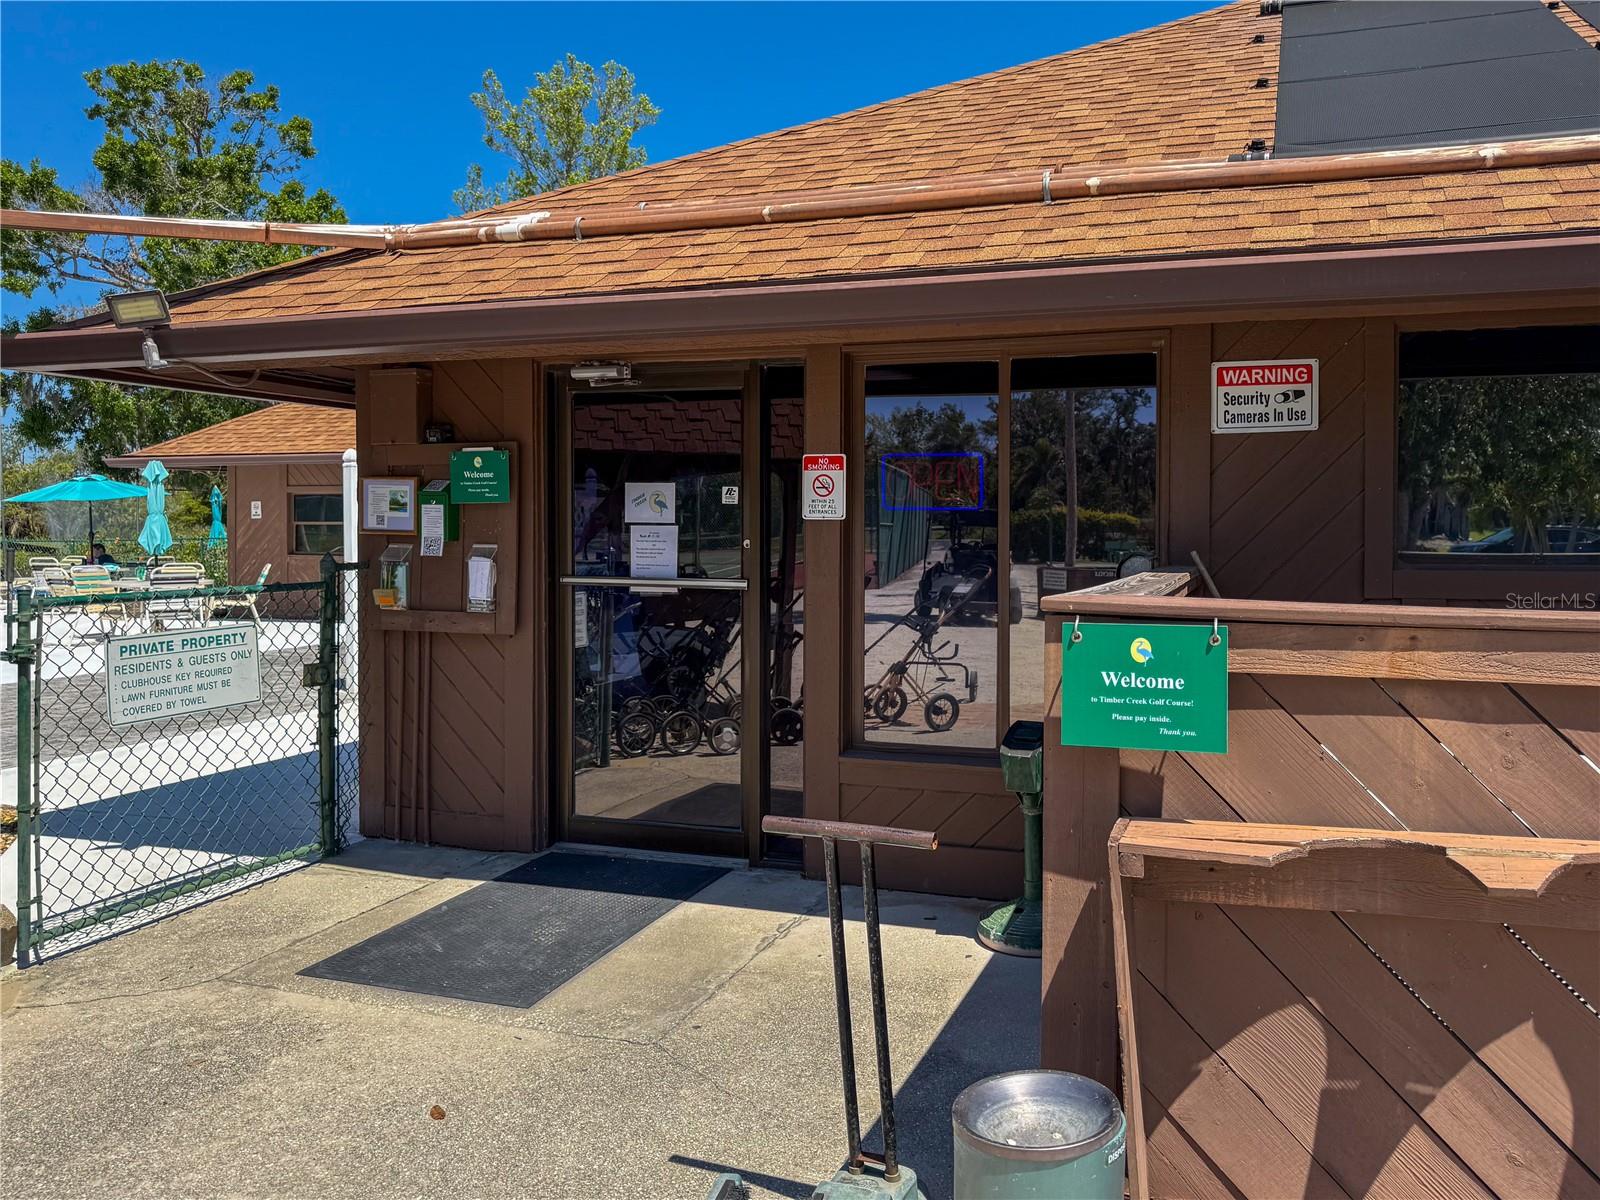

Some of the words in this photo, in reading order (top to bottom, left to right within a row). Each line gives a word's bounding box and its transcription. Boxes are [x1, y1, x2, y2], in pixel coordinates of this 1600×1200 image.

[1222, 367, 1308, 385] WARNING
[1223, 391, 1271, 407] Security
[1223, 410, 1270, 424] Cameras
[1273, 408, 1284, 422] In
[1287, 407, 1307, 421] Use
[887, 460, 978, 504] OPEN
[119, 640, 174, 657] PRIVATE
[181, 632, 247, 650] PROPERTY
[114, 659, 172, 676] RESIDENTS
[177, 658, 184, 667] &
[188, 652, 227, 666] GUESTS
[230, 649, 253, 661] ONLY
[121, 674, 172, 690] CLUBHOUSE
[175, 672, 191, 681] KEY
[194, 666, 233, 679] REQUIRED
[1100, 671, 1185, 690] Welcome
[121, 692, 146, 703] LAWN
[150, 685, 193, 699] FURNITURE
[196, 681, 218, 691] MUST
[221, 679, 231, 687] BE
[122, 702, 162, 717] COVERED
[166, 700, 177, 710] BY
[180, 696, 207, 707] TOWEL
[1099, 696, 1125, 704] Timber
[1126, 697, 1147, 705] Creek
[1149, 698, 1165, 706] Golf
[1166, 699, 1194, 707] Course!
[1112, 713, 1133, 721] Please
[1149, 715, 1172, 723] inside.
[1159, 728, 1181, 736] Thank
